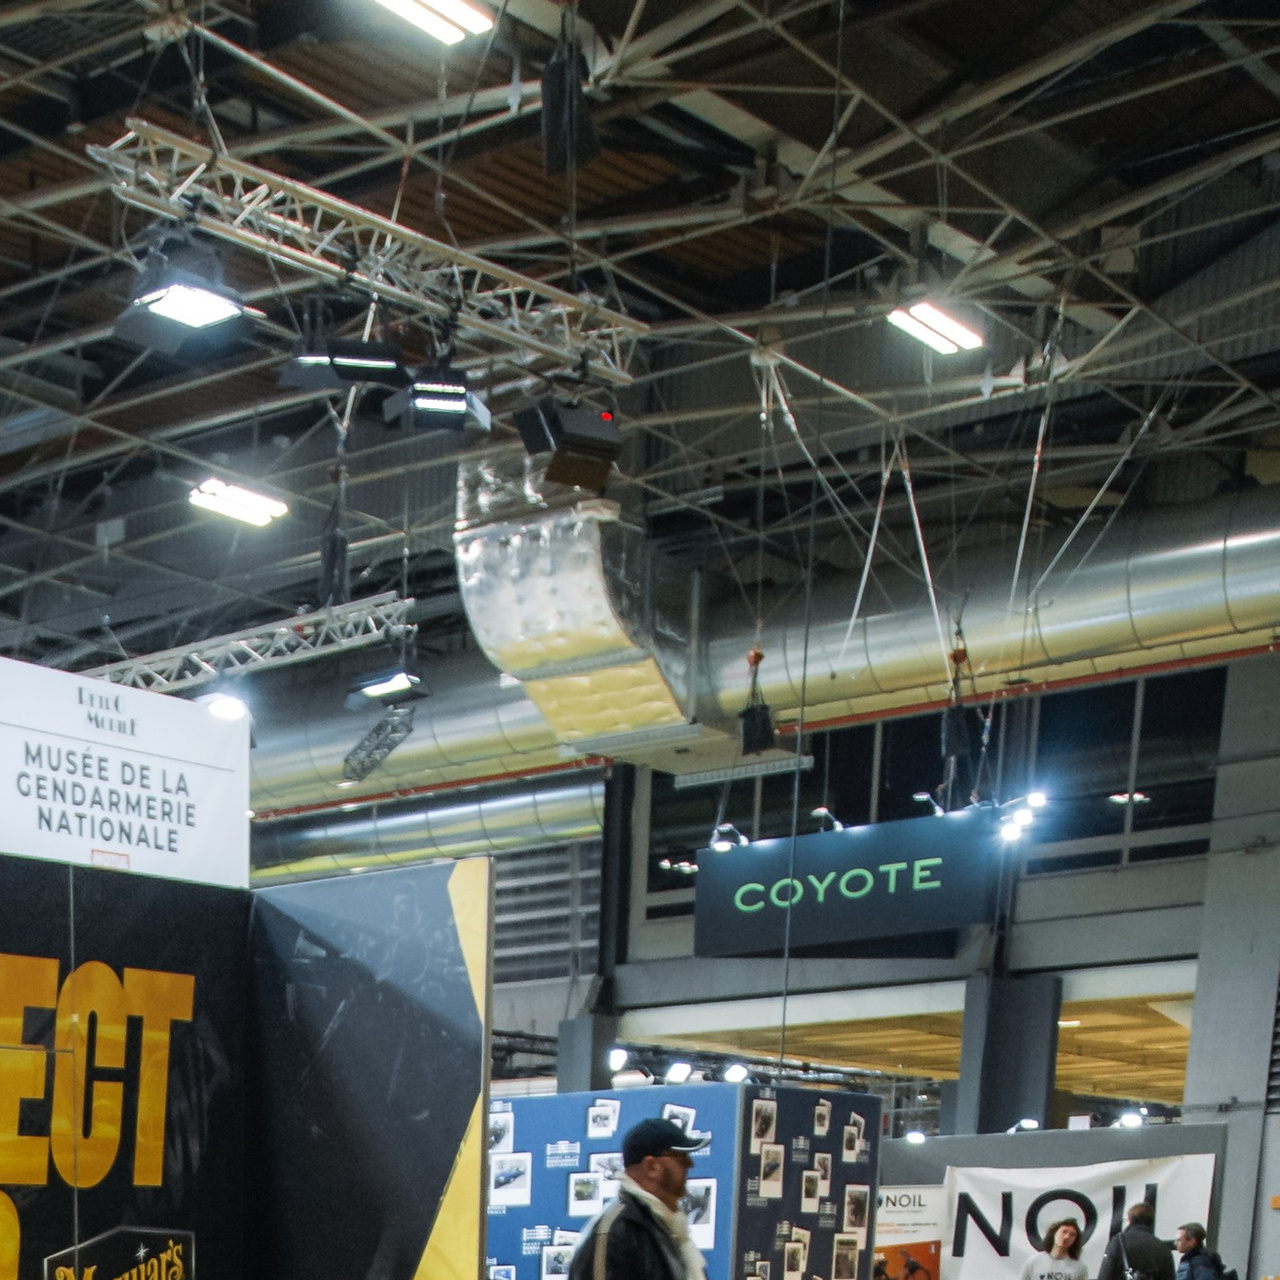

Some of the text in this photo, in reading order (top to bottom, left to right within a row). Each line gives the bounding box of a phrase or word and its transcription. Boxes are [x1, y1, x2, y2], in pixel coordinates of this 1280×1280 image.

[24, 740, 190, 797] MUSÉE DE LA
[17, 770, 196, 827] GENDARMERIE
[38, 804, 178, 852] NATIONALE
[734, 857, 943, 913] COYOTE
[885, 1193, 927, 1208] NOIL
